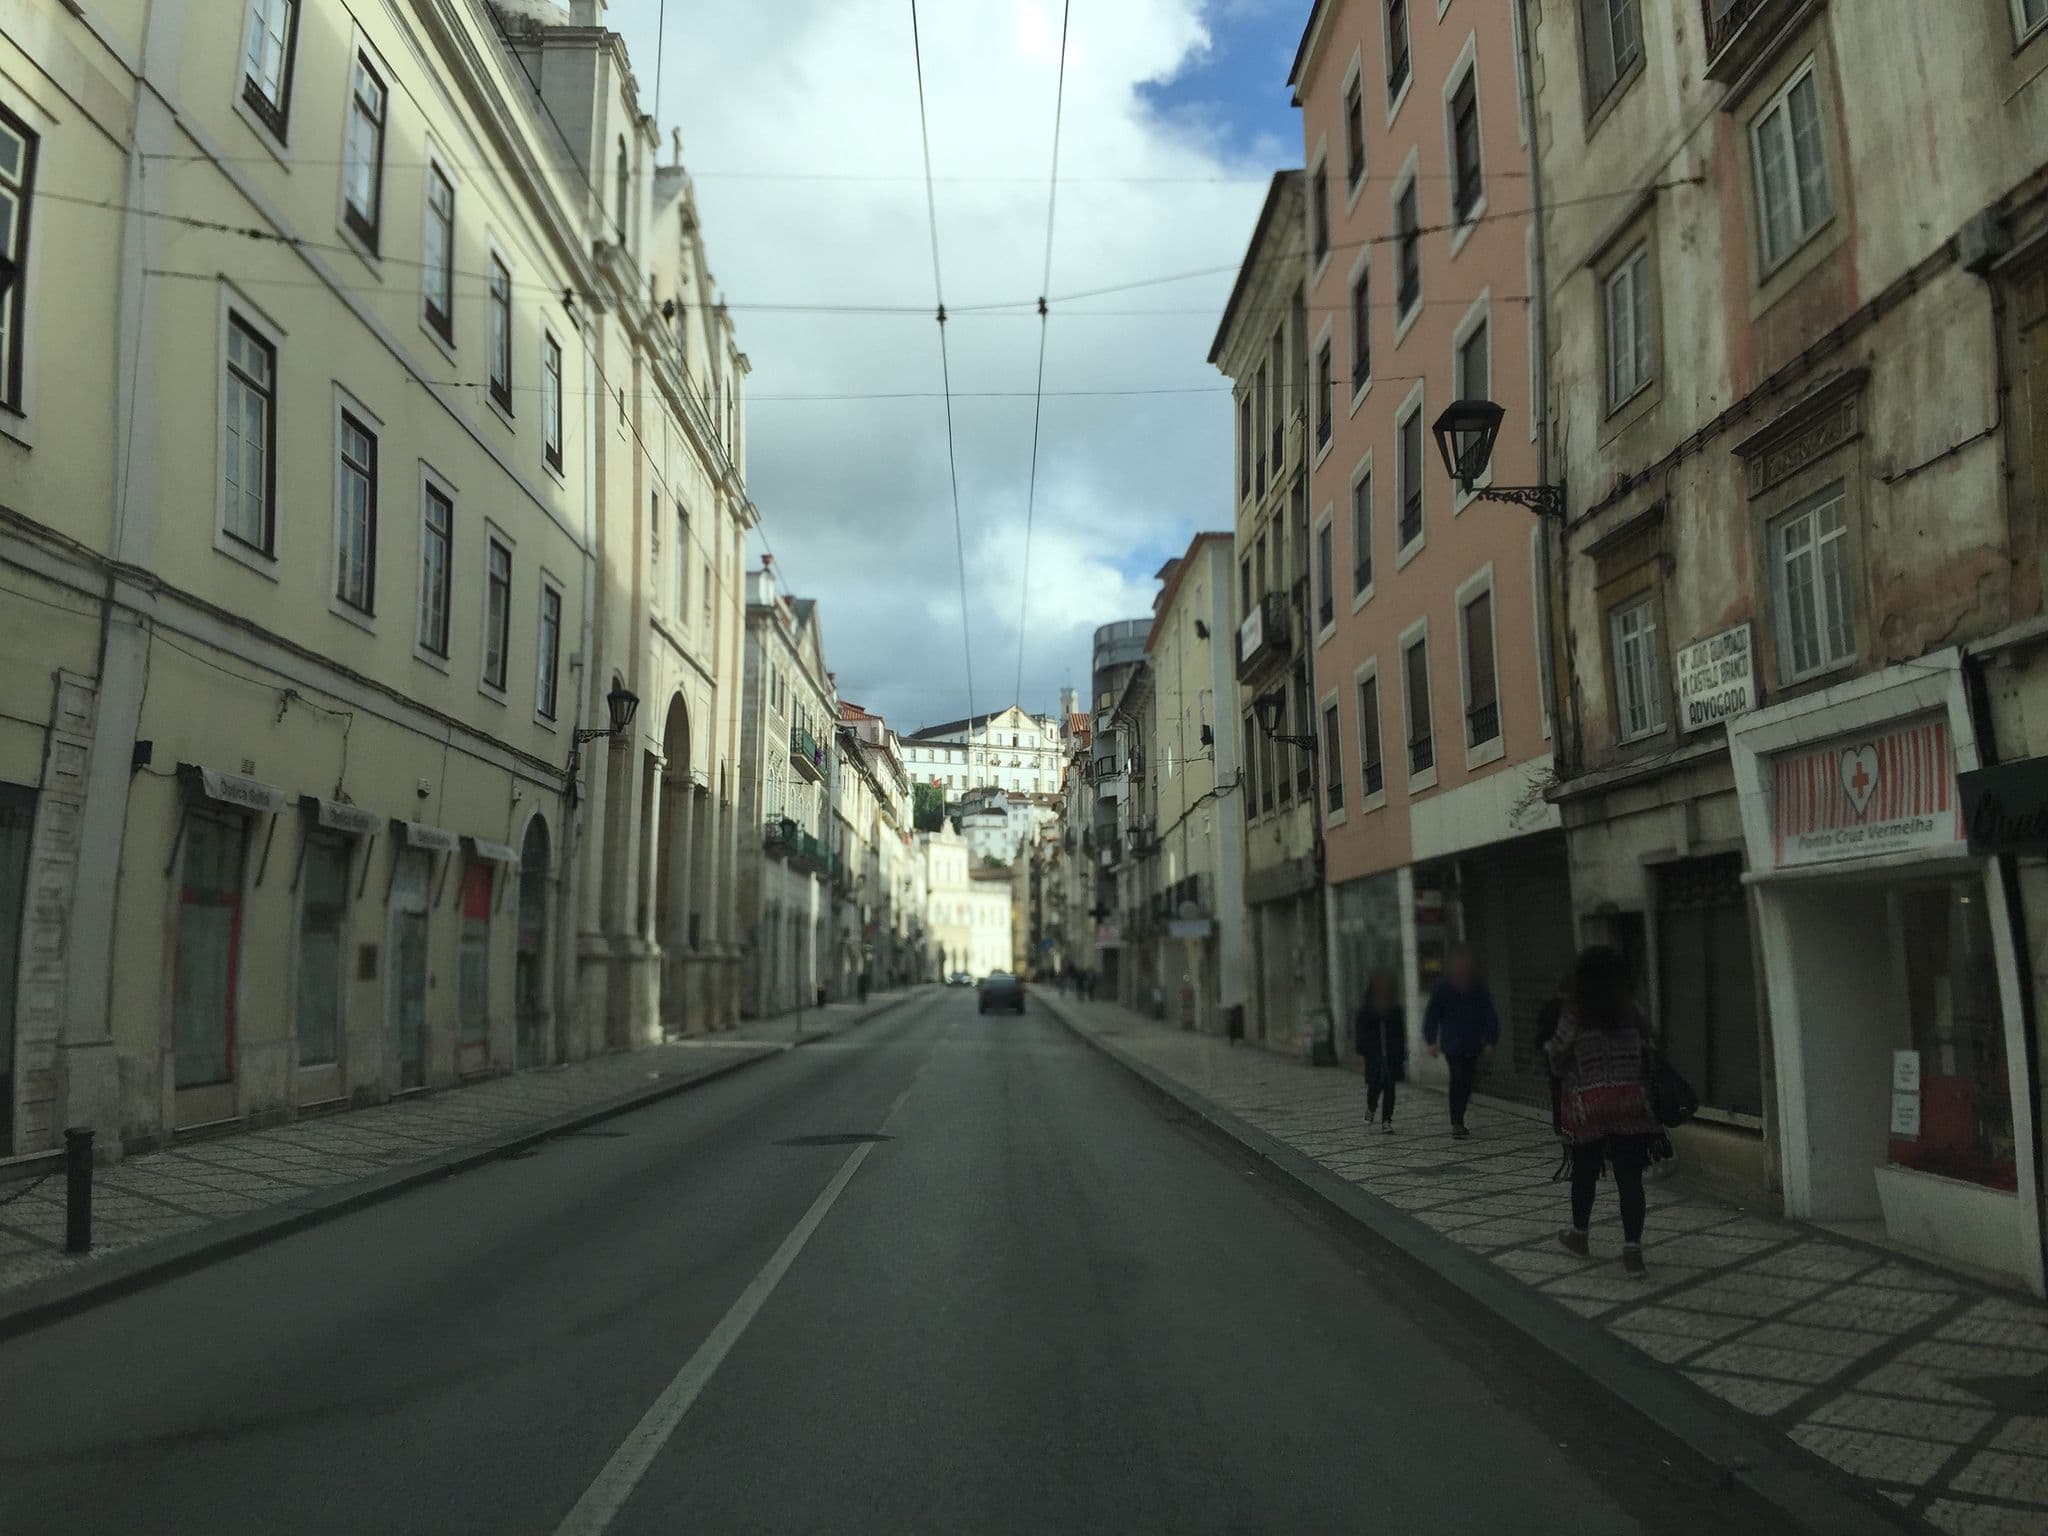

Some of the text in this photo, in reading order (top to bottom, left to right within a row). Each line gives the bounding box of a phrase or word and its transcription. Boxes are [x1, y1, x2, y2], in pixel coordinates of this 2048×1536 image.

[1721, 654, 1748, 685] BRANCO
[1689, 686, 1746, 725] ADVOGADA
[1837, 829, 1864, 844] Cruz
[1868, 817, 1934, 840] Vermelha
